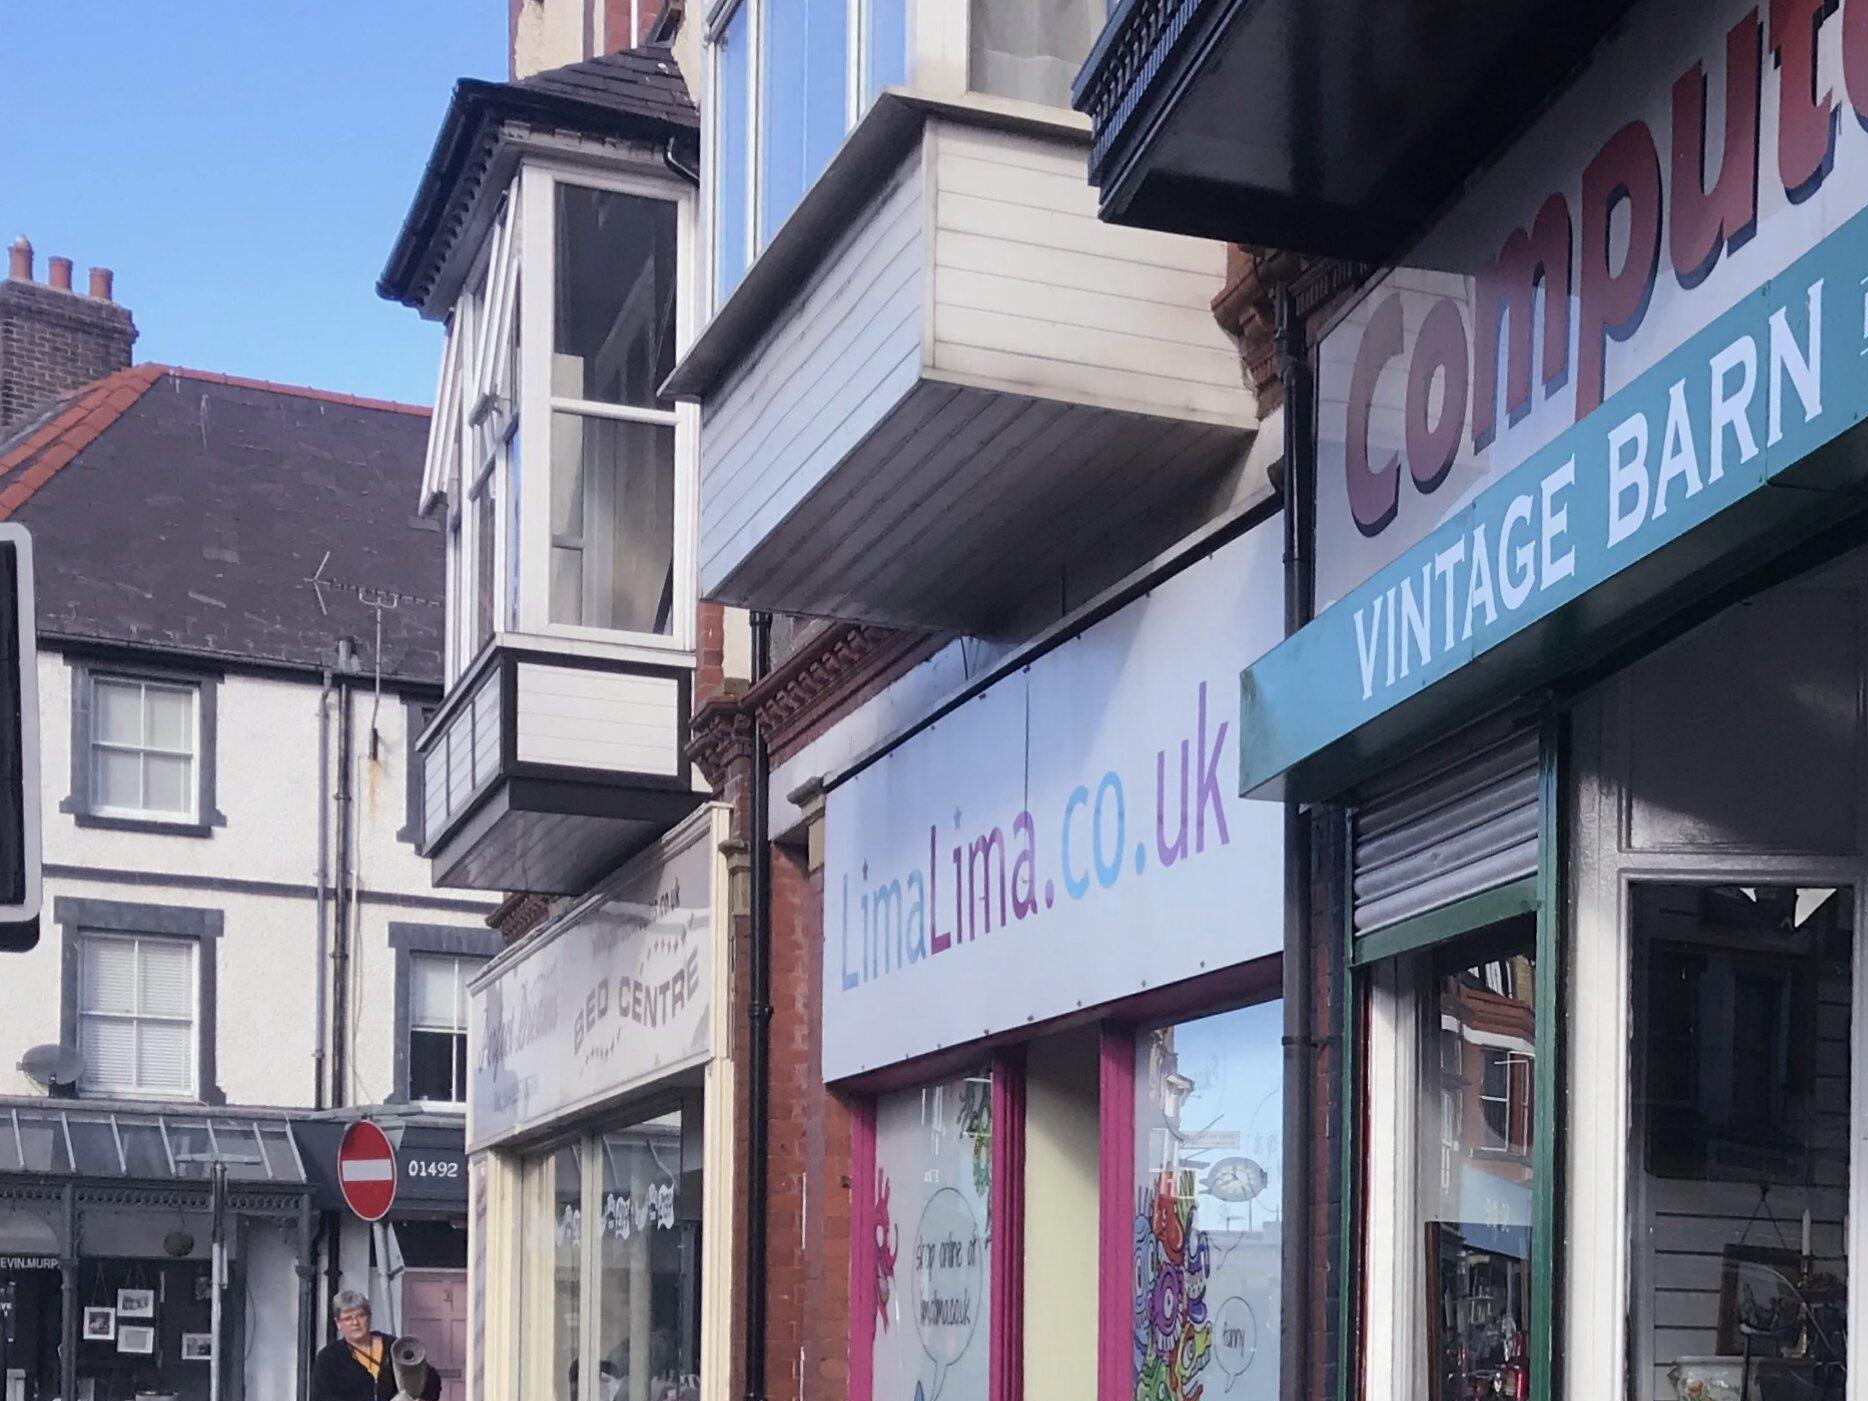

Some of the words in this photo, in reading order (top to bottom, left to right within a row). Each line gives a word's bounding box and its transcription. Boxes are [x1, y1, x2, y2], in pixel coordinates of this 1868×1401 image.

[1353, 454, 1575, 701] VINTAGE
[1607, 278, 1825, 549] BARN
[841, 681, 1231, 992] LimaLima.co.uk
[573, 977, 609, 1055] BED
[618, 945, 700, 1029] CENTRE
[408, 1160, 458, 1177] 01492
[0, 1256, 61, 1270] EVIN.MURP
